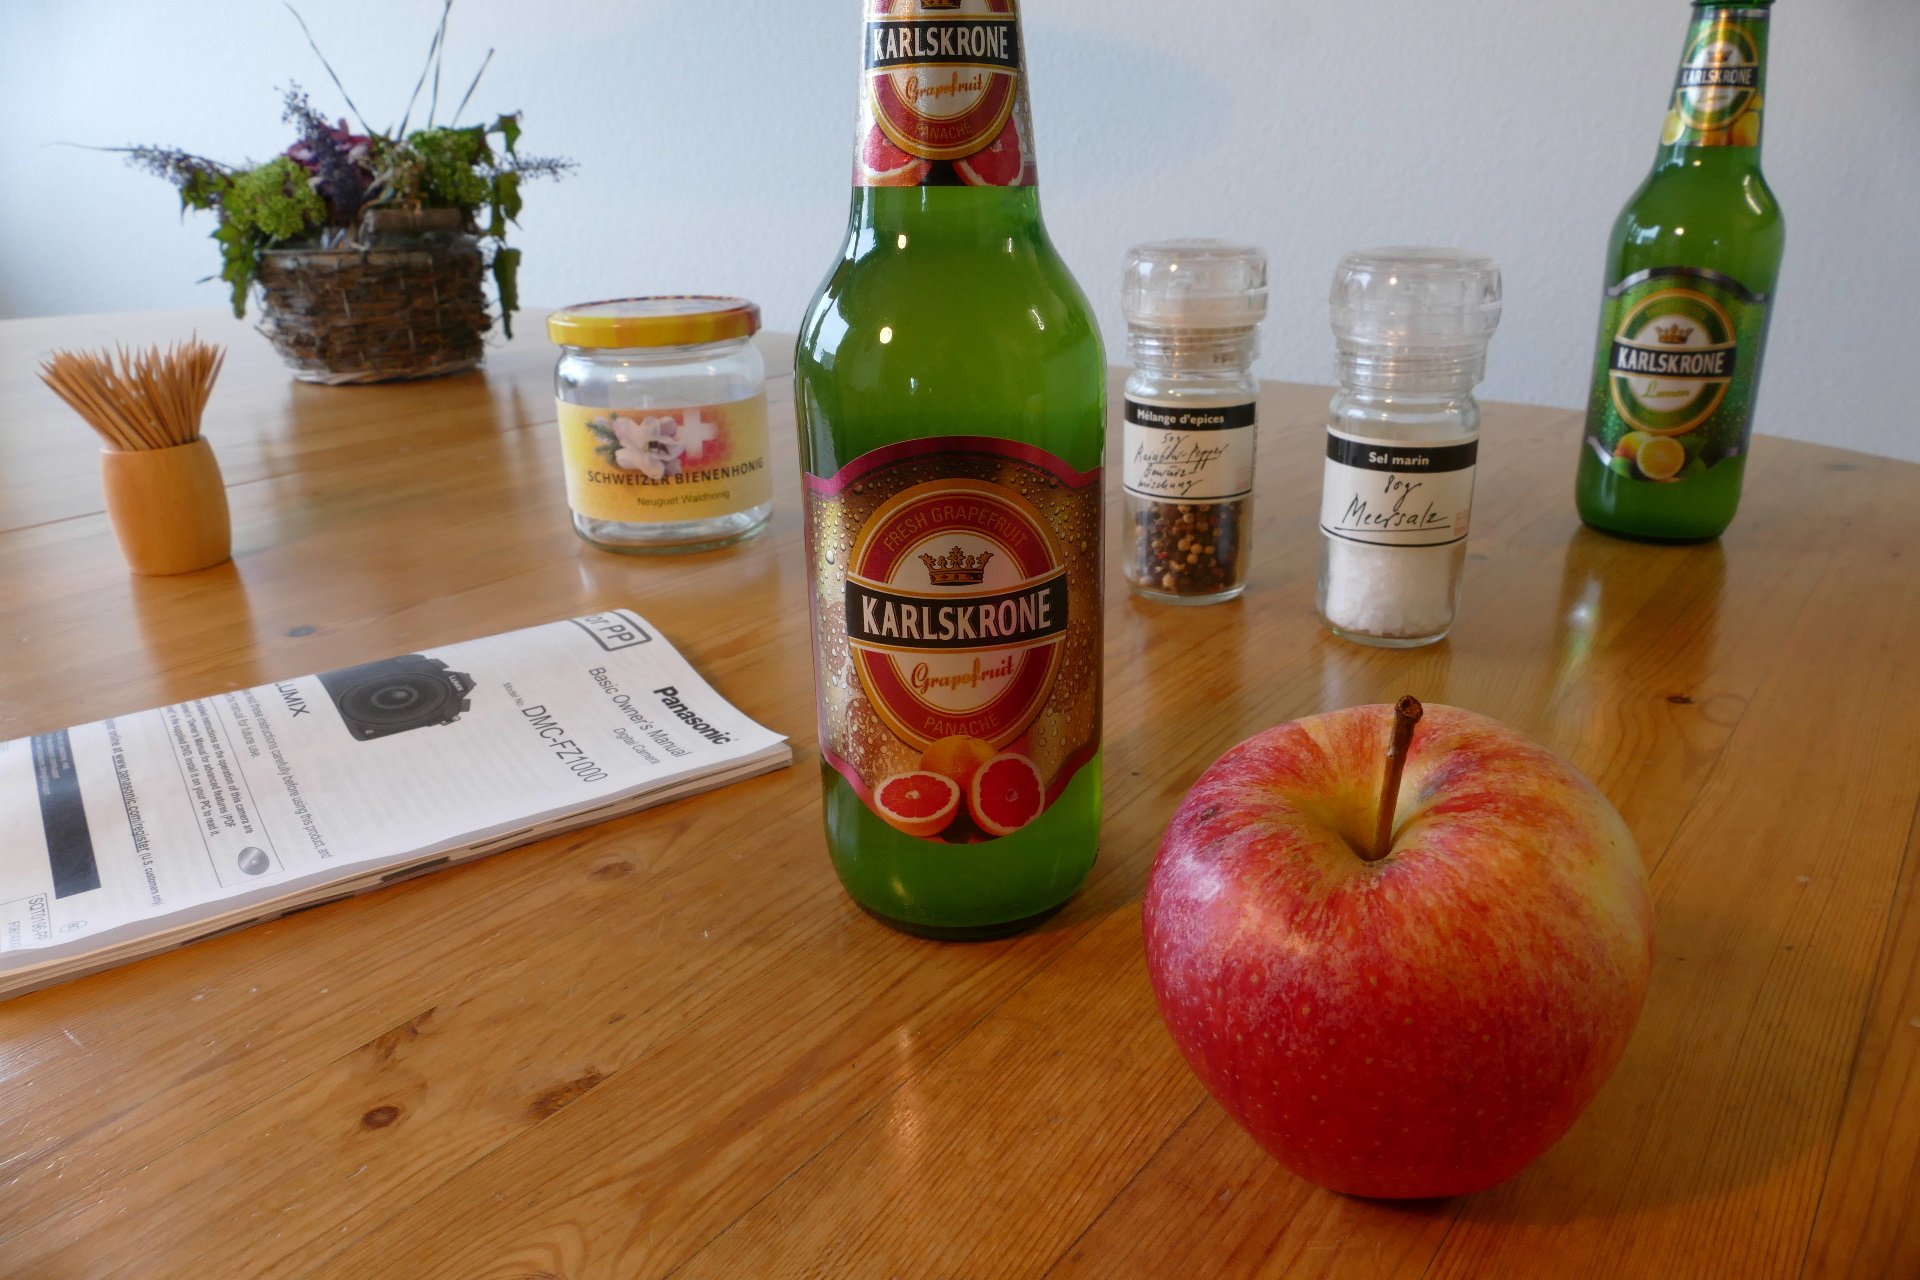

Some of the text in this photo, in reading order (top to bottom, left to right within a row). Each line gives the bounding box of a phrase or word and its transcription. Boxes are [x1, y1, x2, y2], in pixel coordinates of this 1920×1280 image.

[873, 26, 1009, 61] KARLSKRONE
[904, 71, 984, 103] Grapefruit
[1617, 346, 1726, 374] KARLSKRONE
[1137, 408, 1177, 426] Mélange
[587, 457, 764, 486] SCHWEIZER BIENENHONIG
[1368, 451, 1430, 466] Sel marin
[1341, 493, 1448, 529] Meersalz
[883, 505, 1028, 552] FRESH GRAPEFRUIT
[861, 588, 1052, 641] KARLSKRONE
[598, 624, 636, 641] PP
[910, 655, 1016, 695] Grapefruit
[274, 683, 311, 718] UMIX
[589, 667, 693, 758] Basic Owner's Manual
[652, 686, 732, 745] Panasonic
[215, 750, 225, 758] the
[521, 704, 609, 783] DMC-FZ1000
[613, 727, 661, 765] Digital Camera
[217, 759, 235, 785] operation
[257, 717, 278, 750] instructions
[272, 749, 291, 776] carefully
[282, 774, 299, 797] before
[292, 797, 308, 815] using
[300, 813, 312, 825] this
[113, 753, 151, 853] www.panasonic.com/register
[192, 786, 206, 800] your
[200, 800, 212, 810] PC
[203, 763, 221, 790] advanced
[213, 789, 228, 814] features
[231, 791, 243, 804] this
[205, 817, 219, 831] read
[235, 803, 250, 825] camera
